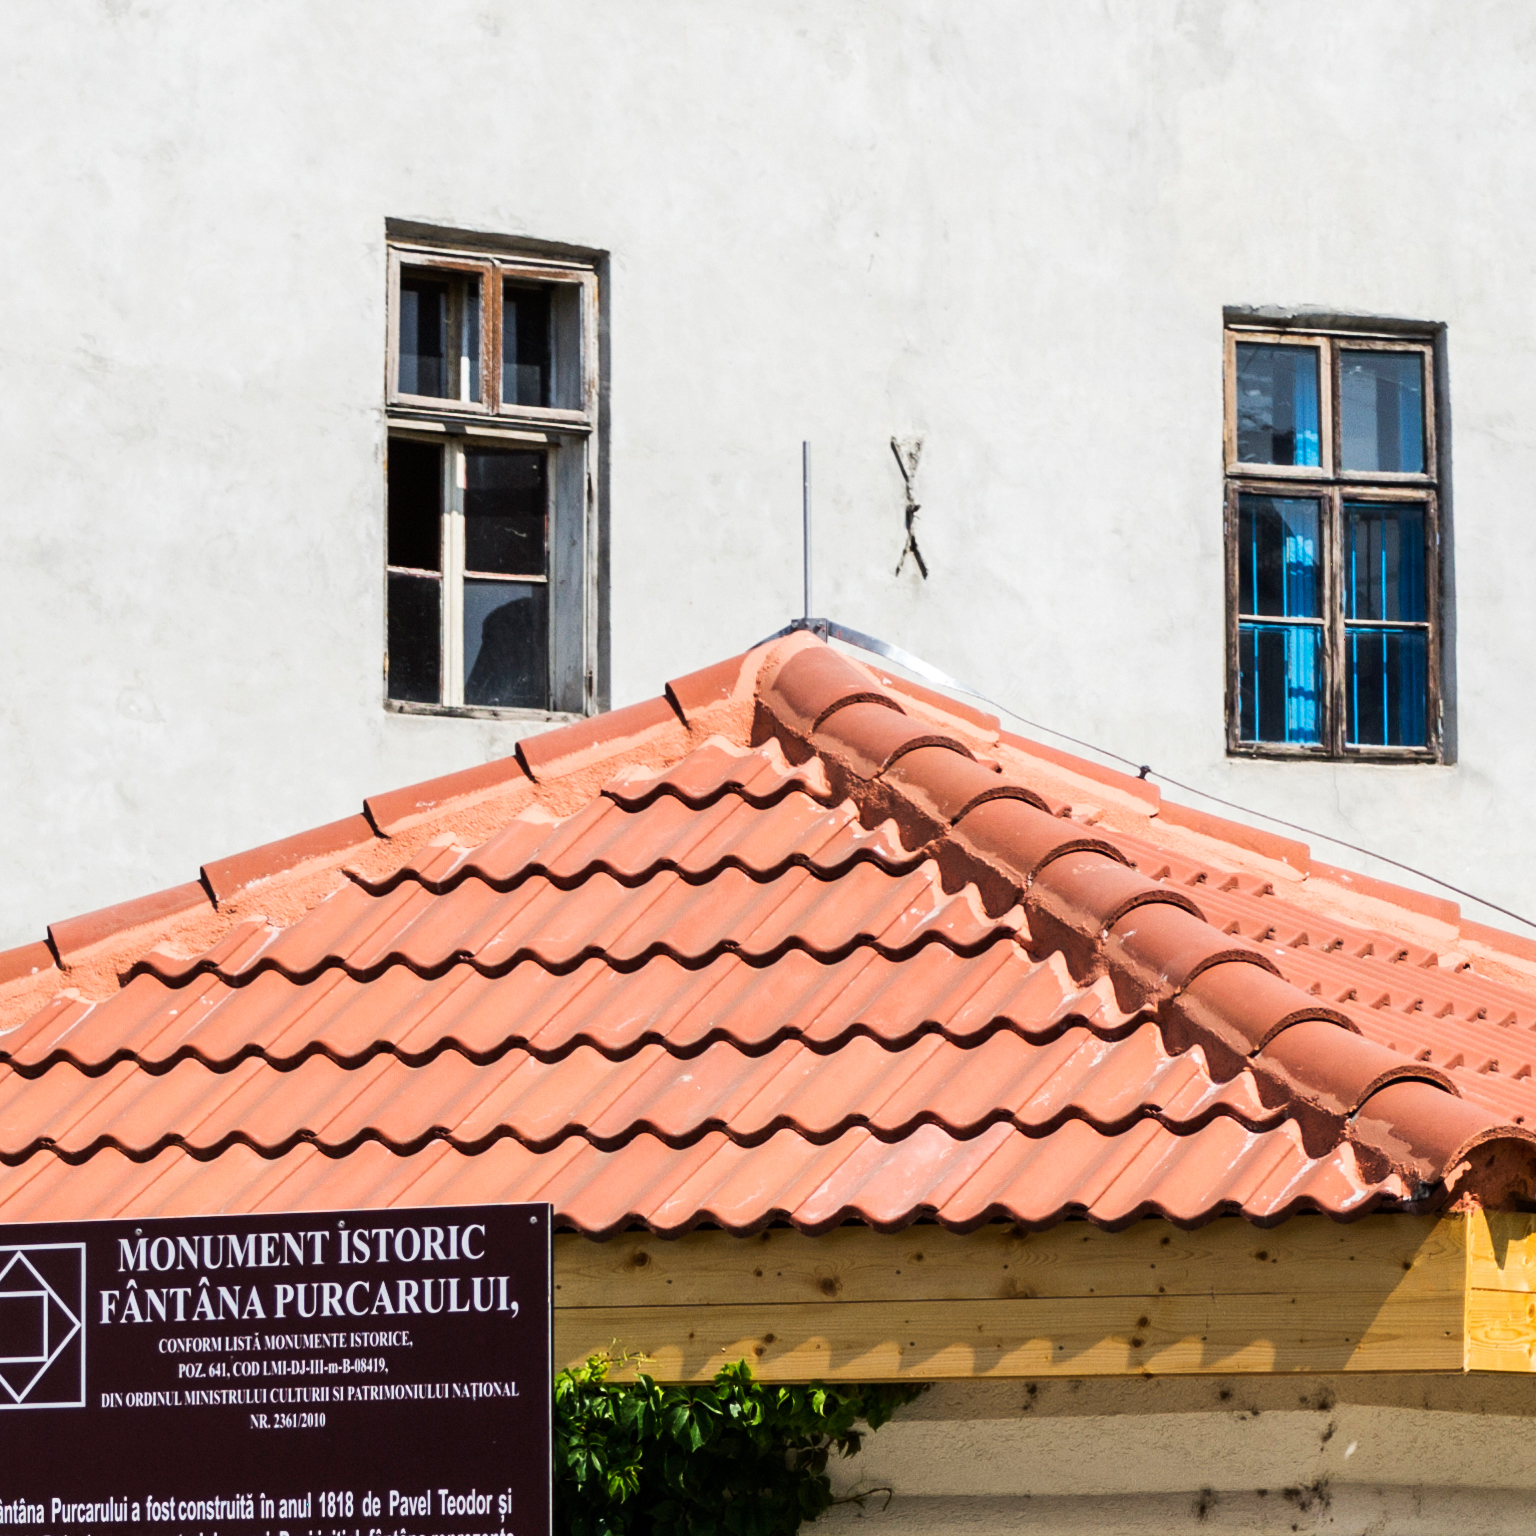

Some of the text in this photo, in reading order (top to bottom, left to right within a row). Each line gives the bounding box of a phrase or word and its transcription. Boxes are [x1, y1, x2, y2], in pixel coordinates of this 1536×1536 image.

[118, 1224, 485, 1272] MONUMENT ISTORIC
[100, 1276, 519, 1324] FÂNTÂNA PURCARULUI,
[158, 1331, 413, 1353] CONFORM LISTĂ MONUMENTE ISTORICE,
[179, 1363, 206, 1378] POZ.
[208, 1362, 230, 1377] 641,
[232, 1361, 260, 1377] COD
[101, 1393, 122, 1408] DIN
[125, 1391, 182, 1407] ORDINUL
[185, 1388, 267, 1405] MINISTRULUI
[270, 1387, 329, 1403] CULTURII
[348, 1383, 449, 1401] PATRIMONIULUI
[452, 1381, 519, 1400] NAȚIONAL
[250, 1412, 326, 1429] NR. 2361/2010
[51, 1496, 127, 1523] Purcarului
[131, 1502, 140, 1522] a
[146, 1495, 176, 1521] fost
[178, 1493, 254, 1521] construită
[260, 1492, 274, 1519] în
[279, 1492, 311, 1519] anul
[319, 1491, 354, 1518] 1818
[362, 1490, 381, 1517] de
[389, 1489, 431, 1516] Pavel
[438, 1488, 493, 1515] Teodor
[498, 1488, 512, 1523] și
